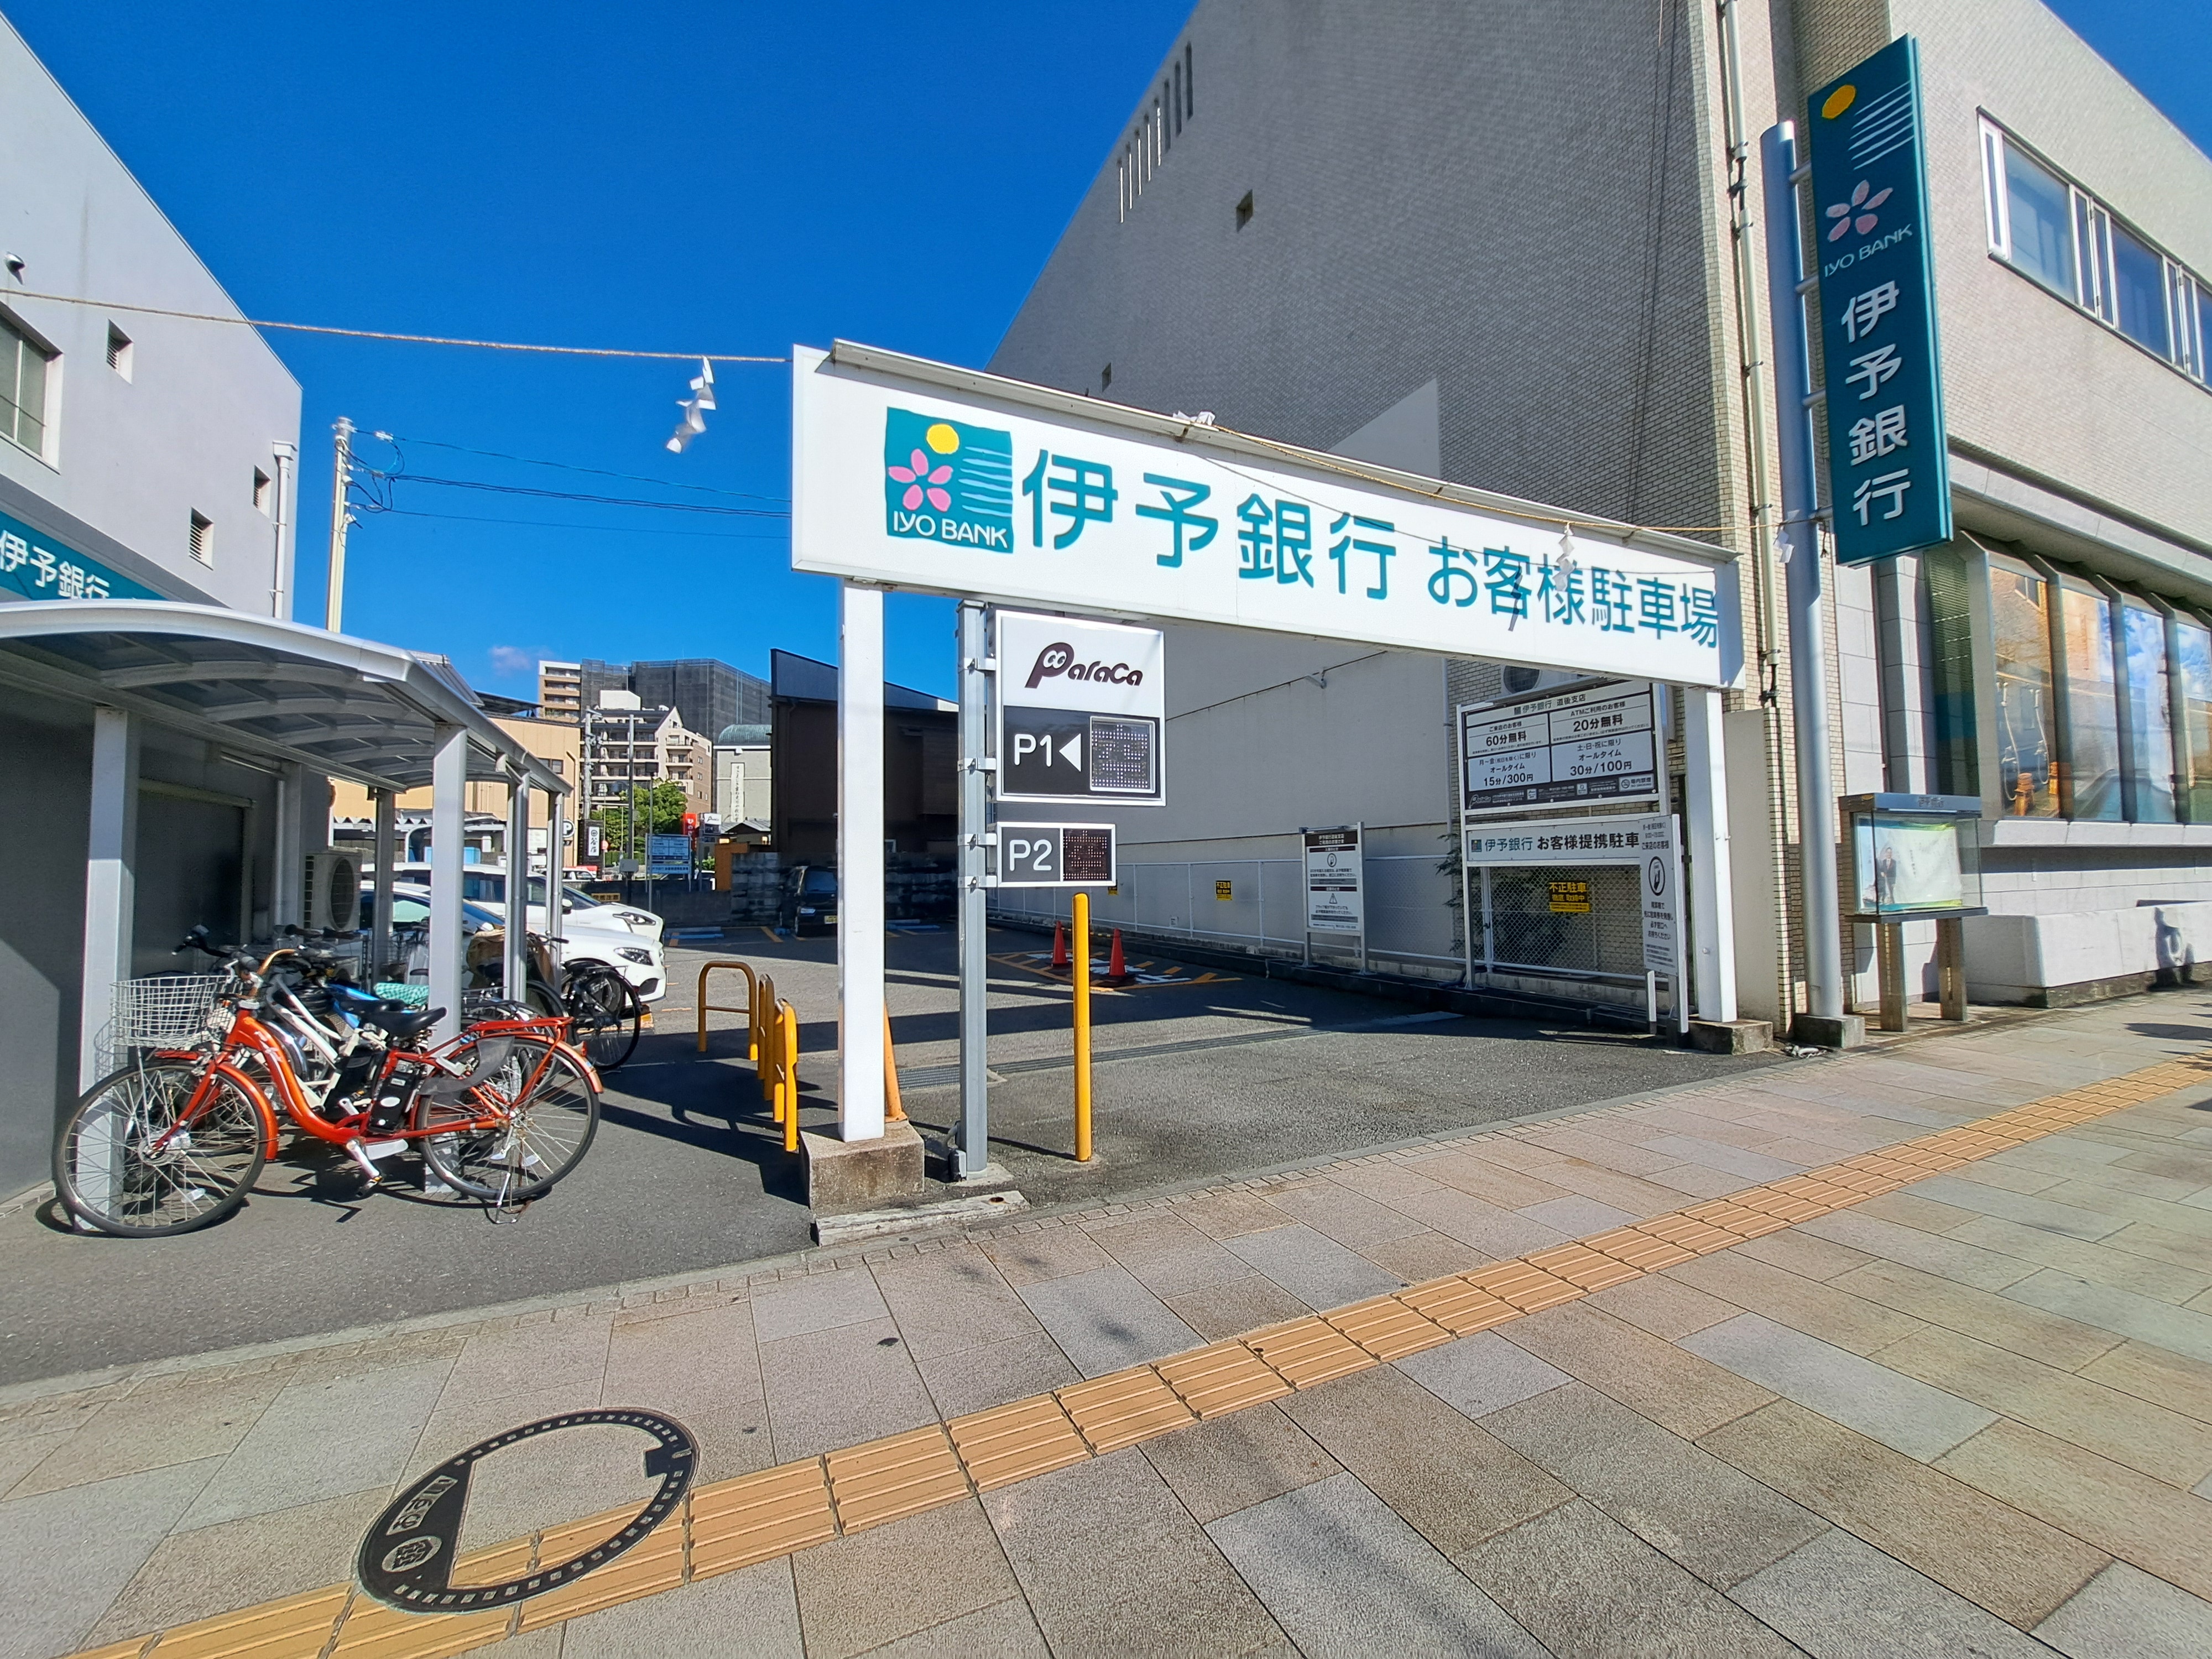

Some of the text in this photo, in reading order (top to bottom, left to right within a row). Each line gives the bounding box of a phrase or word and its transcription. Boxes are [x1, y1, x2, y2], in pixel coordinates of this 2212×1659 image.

[1824, 224, 1912, 278] IYO BANK
[1841, 279, 1911, 526] 伊予銀行
[893, 510, 1009, 549] IYO BANK
[1022, 448, 1718, 648] 伊予銀行 お客様駐車場
[0, 530, 109, 599] 伊予銀行
[1523, 694, 1586, 713] 伊予銀行 道後支店
[1571, 701, 1626, 717] ATMご利用のお客様
[1489, 722, 1522, 732] ご来店のお客様
[1573, 713, 1623, 732] 20分無料
[1486, 731, 1526, 747] 60分無料
[1014, 733, 1052, 768] P1
[1579, 749, 1621, 761] オールタイム
[1490, 764, 1525, 773] オールタイム
[1570, 760, 1632, 776] 30分/100円
[1484, 773, 1533, 786] 15分/300円
[1485, 837, 1533, 852] 伊予銀行
[1009, 839, 1052, 872] P2
[1549, 882, 1587, 893] 不正駐車
